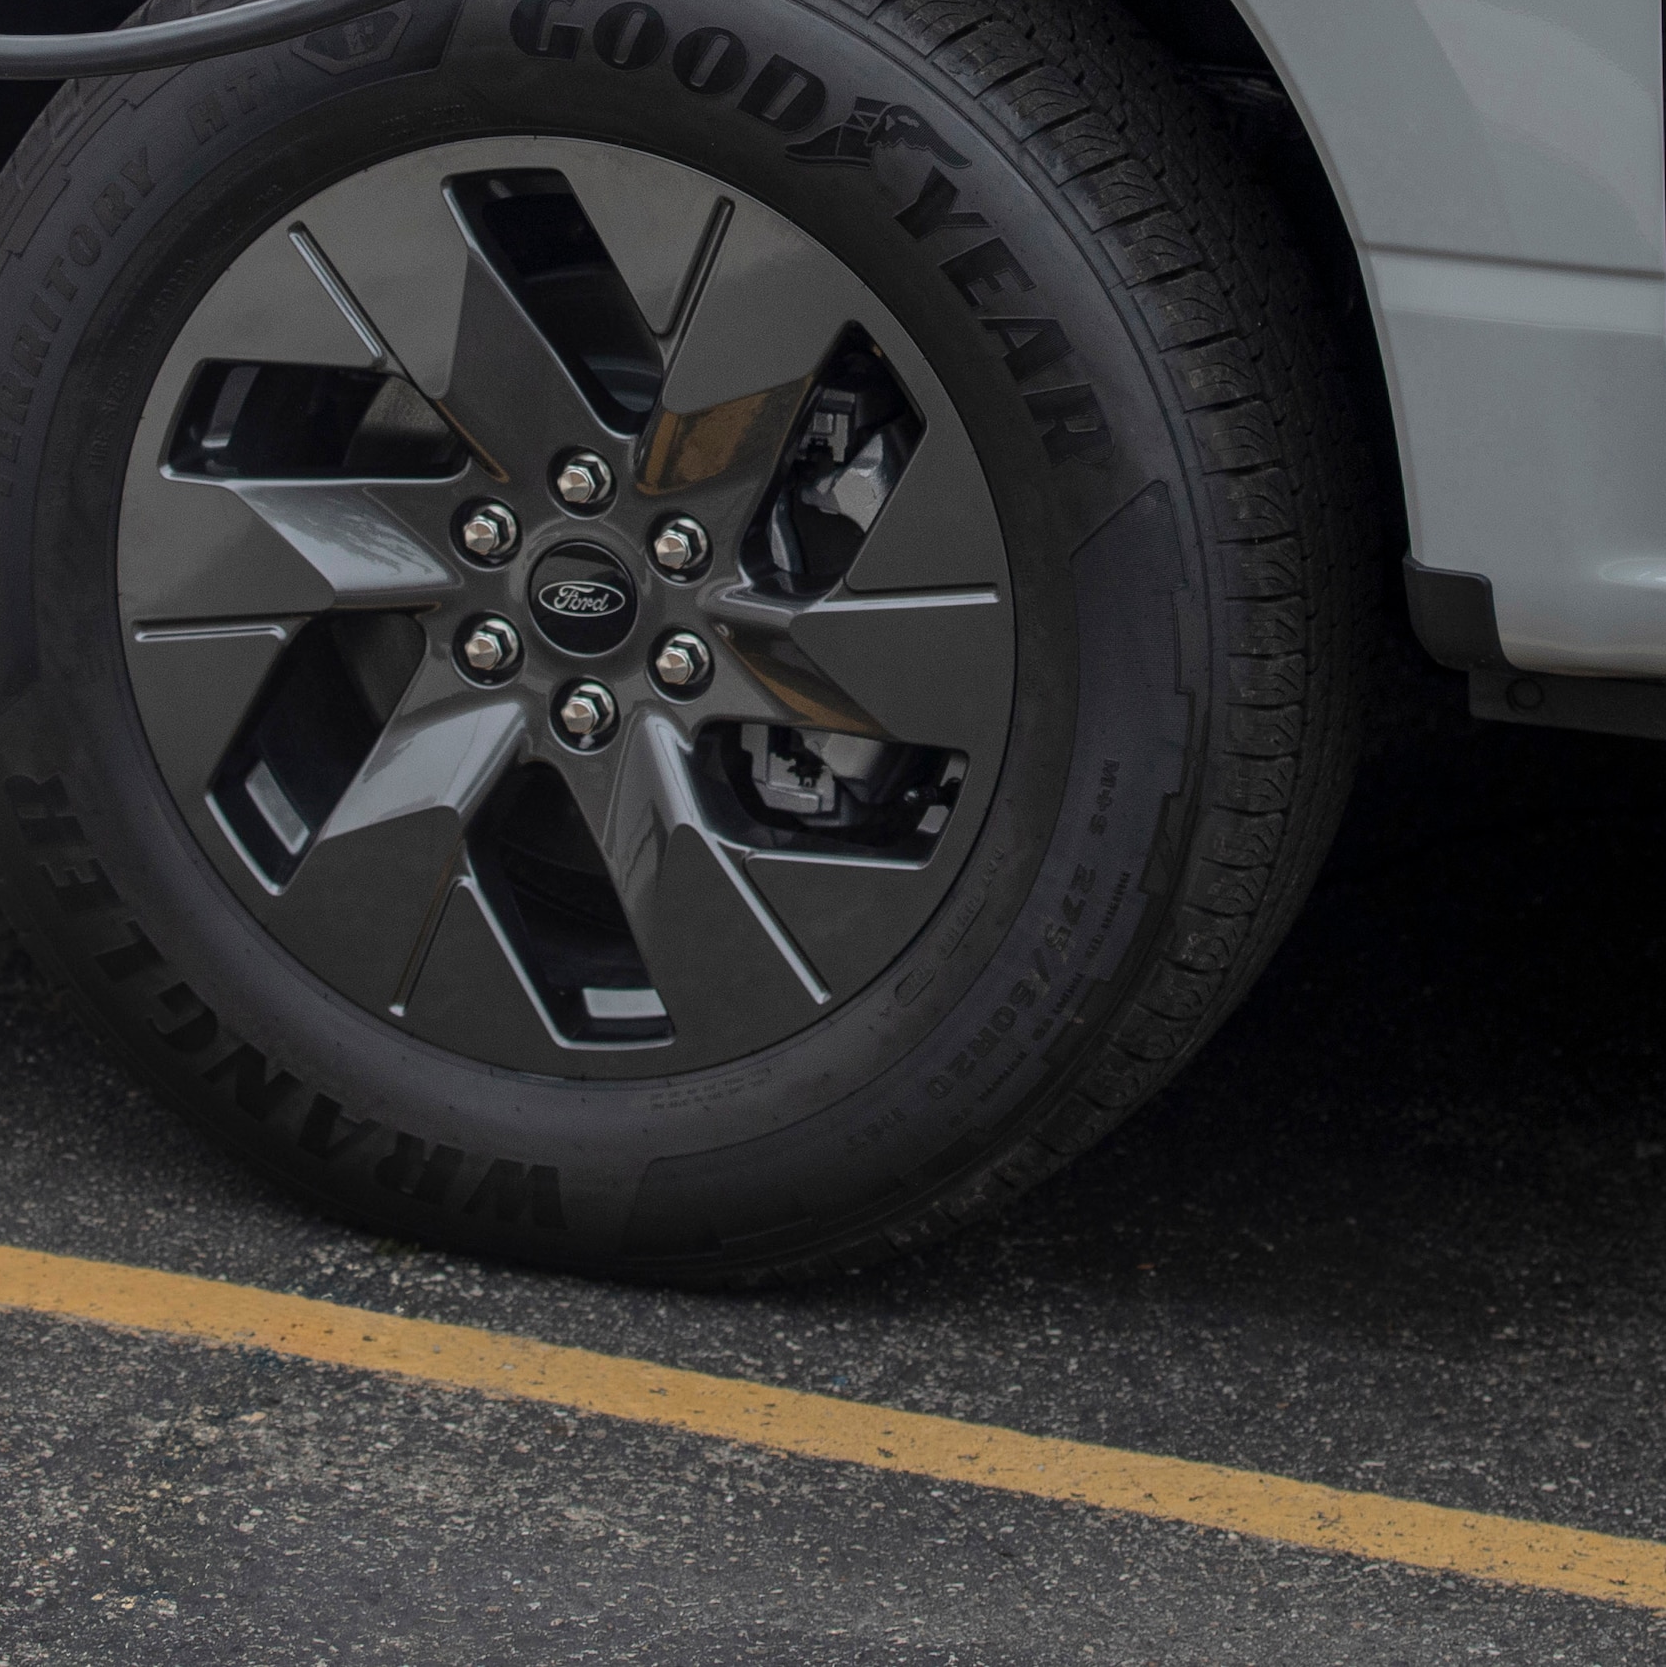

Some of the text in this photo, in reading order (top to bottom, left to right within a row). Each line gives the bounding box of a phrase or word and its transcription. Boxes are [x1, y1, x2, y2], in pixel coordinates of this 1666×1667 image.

[554, 585, 609, 611] Ford
[1085, 759, 1118, 837] M+S
[4, 774, 567, 1230] WRANGLER
[921, 862, 1097, 1105] 275/60R20
